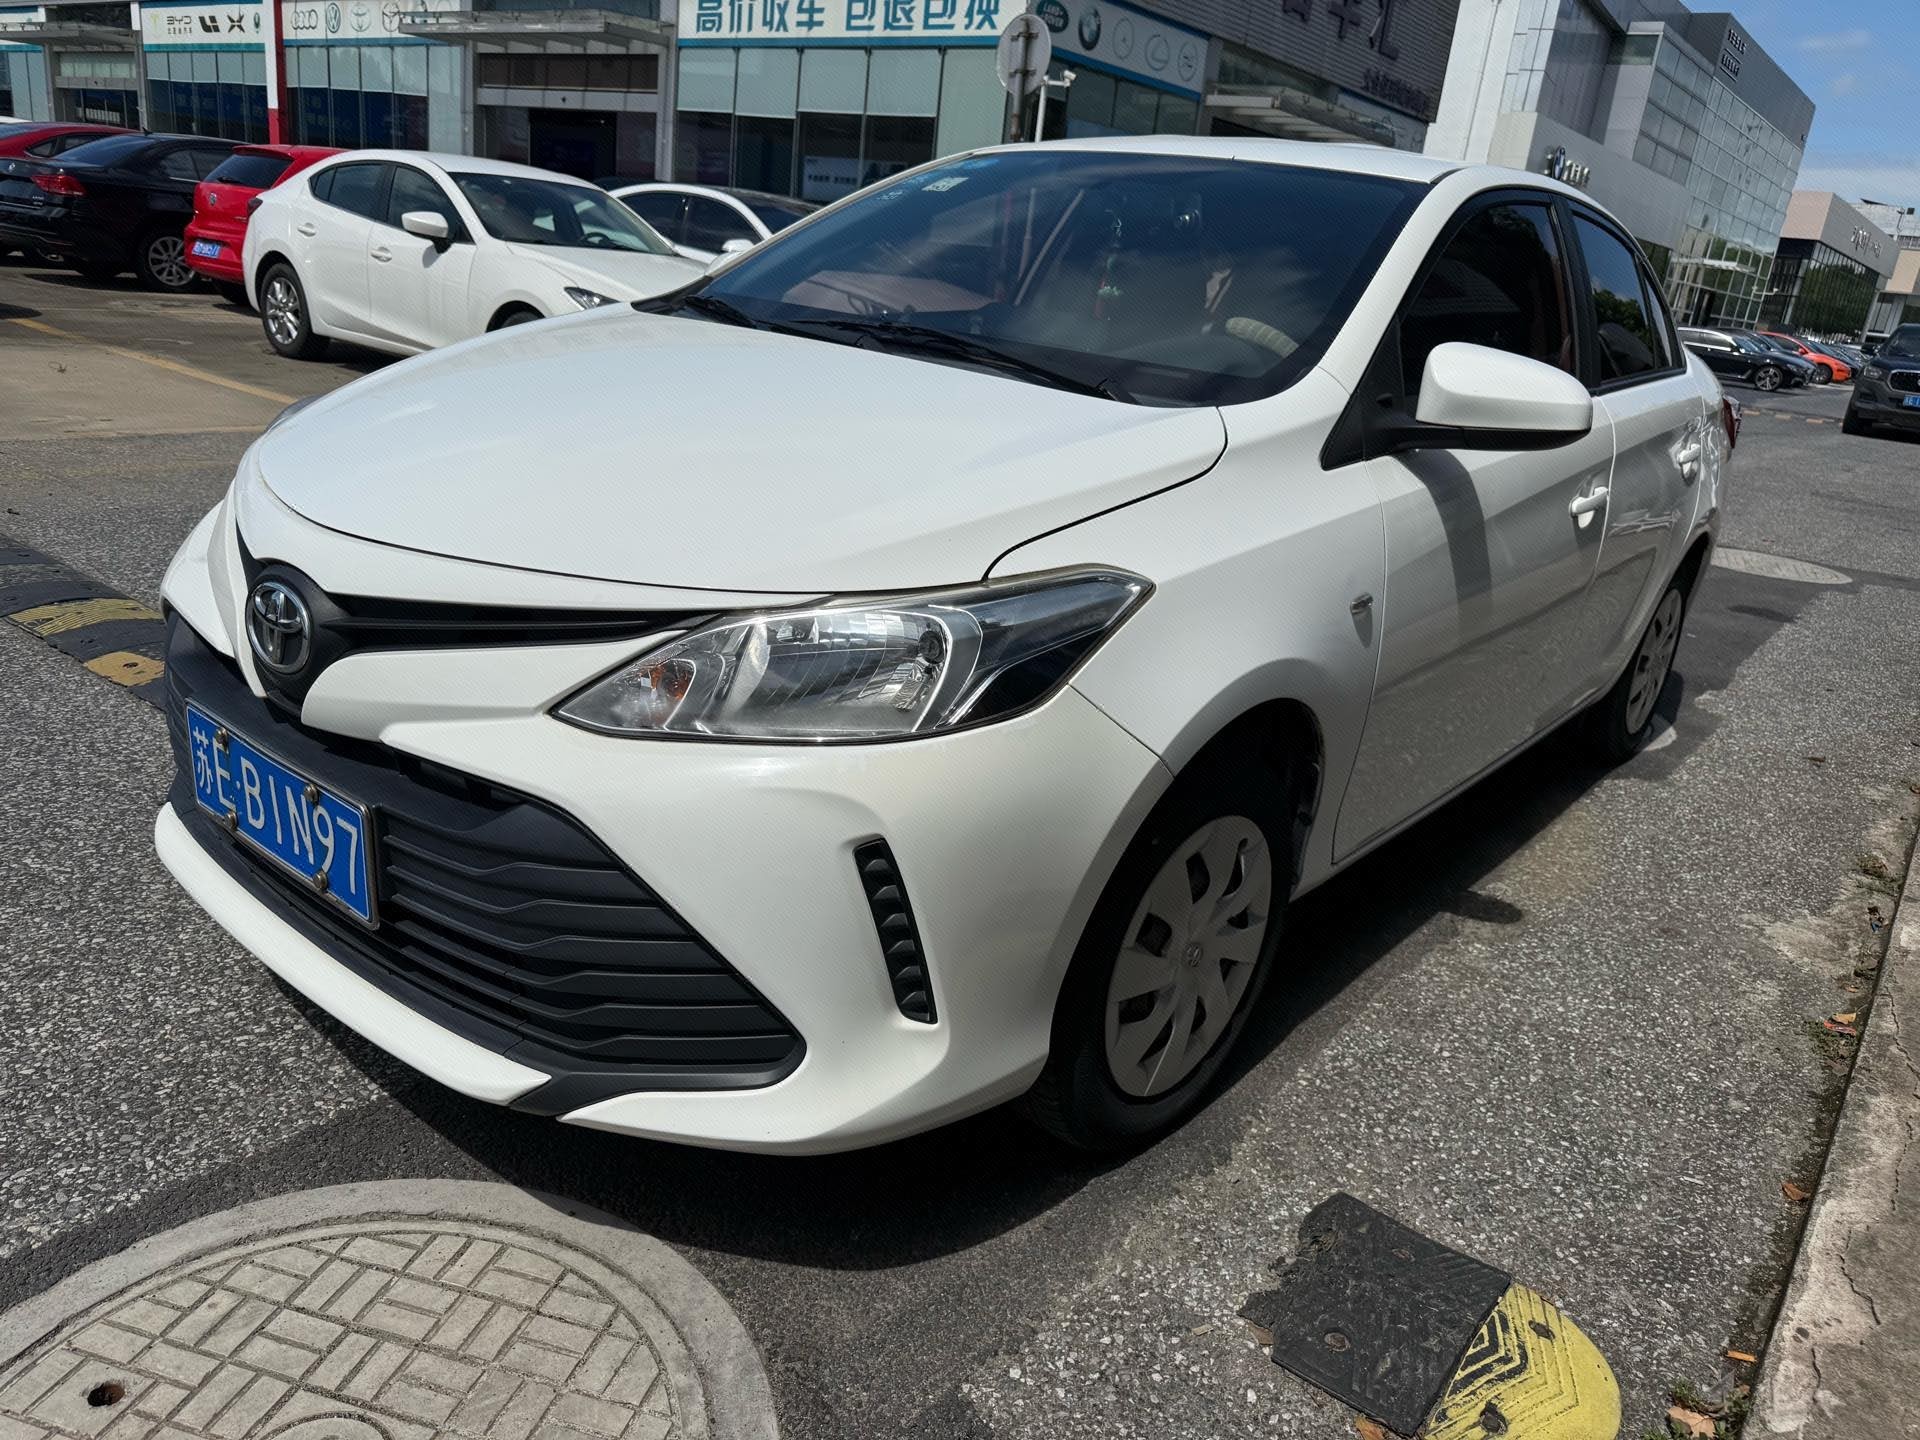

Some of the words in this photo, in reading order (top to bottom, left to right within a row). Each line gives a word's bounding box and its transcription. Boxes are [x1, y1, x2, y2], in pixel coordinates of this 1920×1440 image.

[166, 15, 192, 25] BYD
[696, 0, 825, 33] 高价收车
[845, 0, 1000, 32] 包退包换
